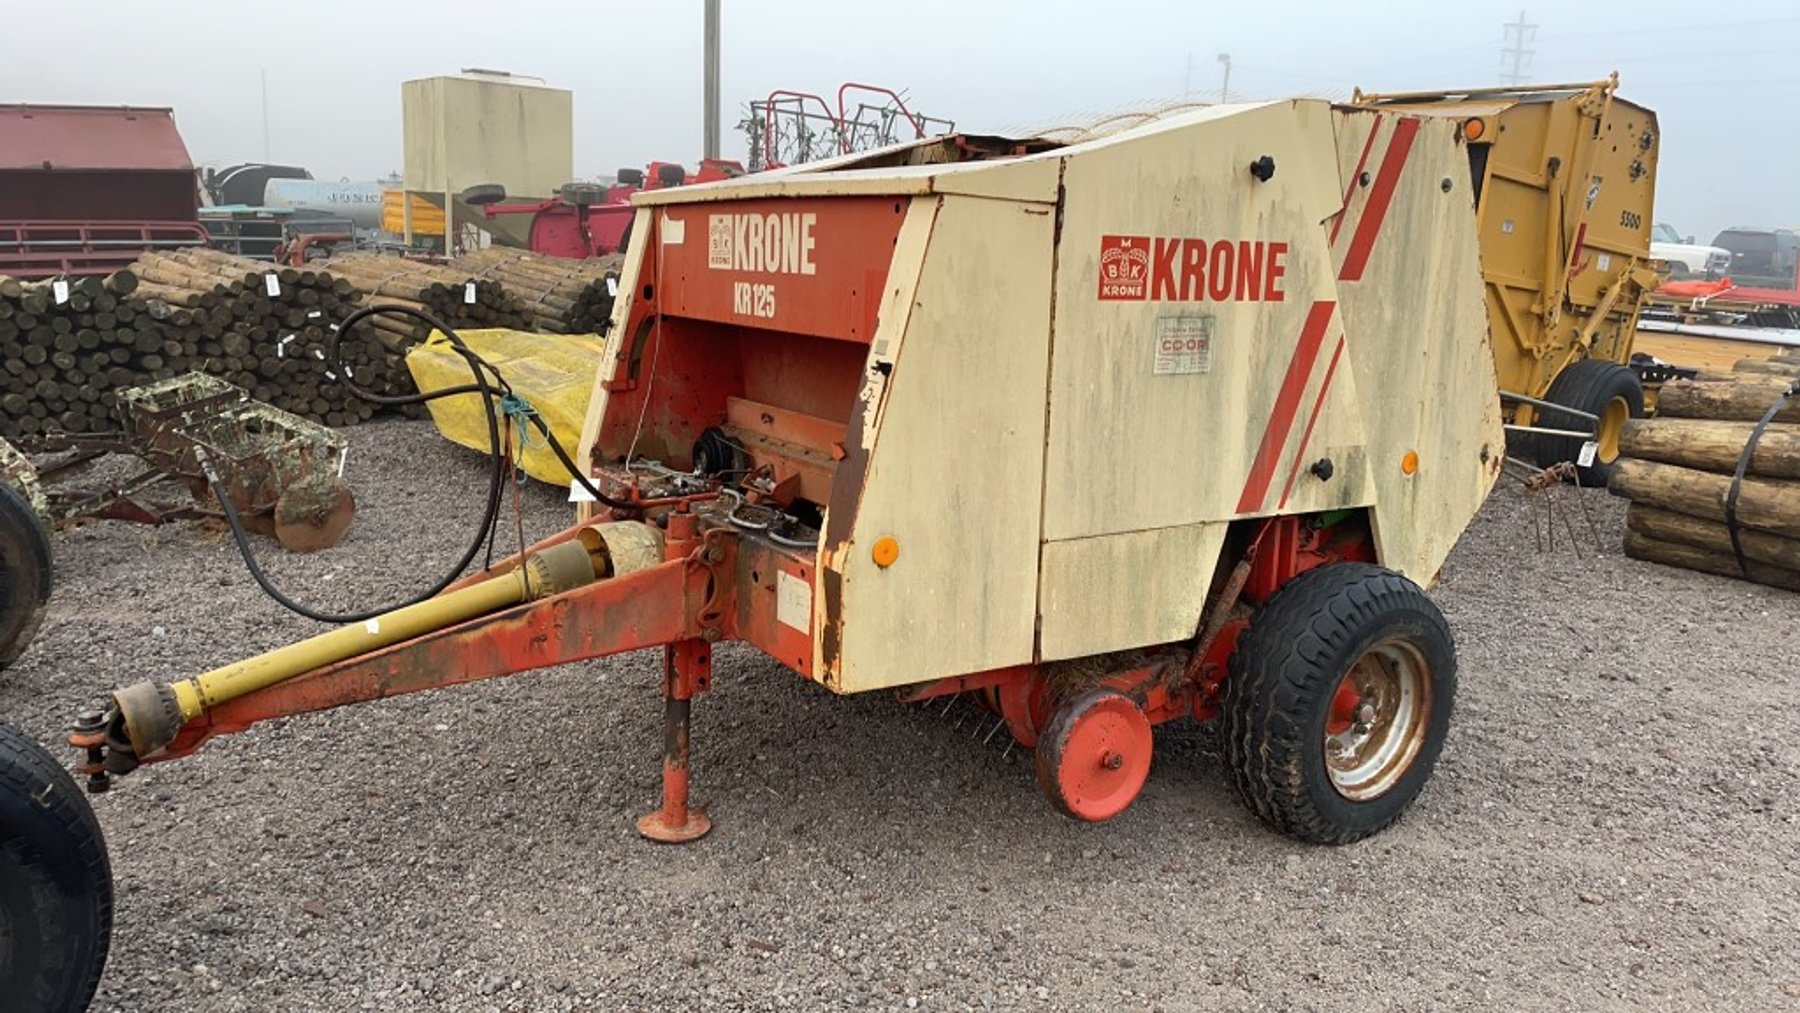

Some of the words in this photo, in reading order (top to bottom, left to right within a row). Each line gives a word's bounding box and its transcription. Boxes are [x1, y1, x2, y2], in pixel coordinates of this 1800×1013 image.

[1620, 210, 1641, 230] 5500
[734, 212, 817, 275] KRONE
[1121, 237, 1132, 248] M
[1108, 264, 1118, 278] B
[1130, 264, 1142, 279] K
[1151, 236, 1289, 302] KRONE
[1102, 284, 1143, 297] KRONE
